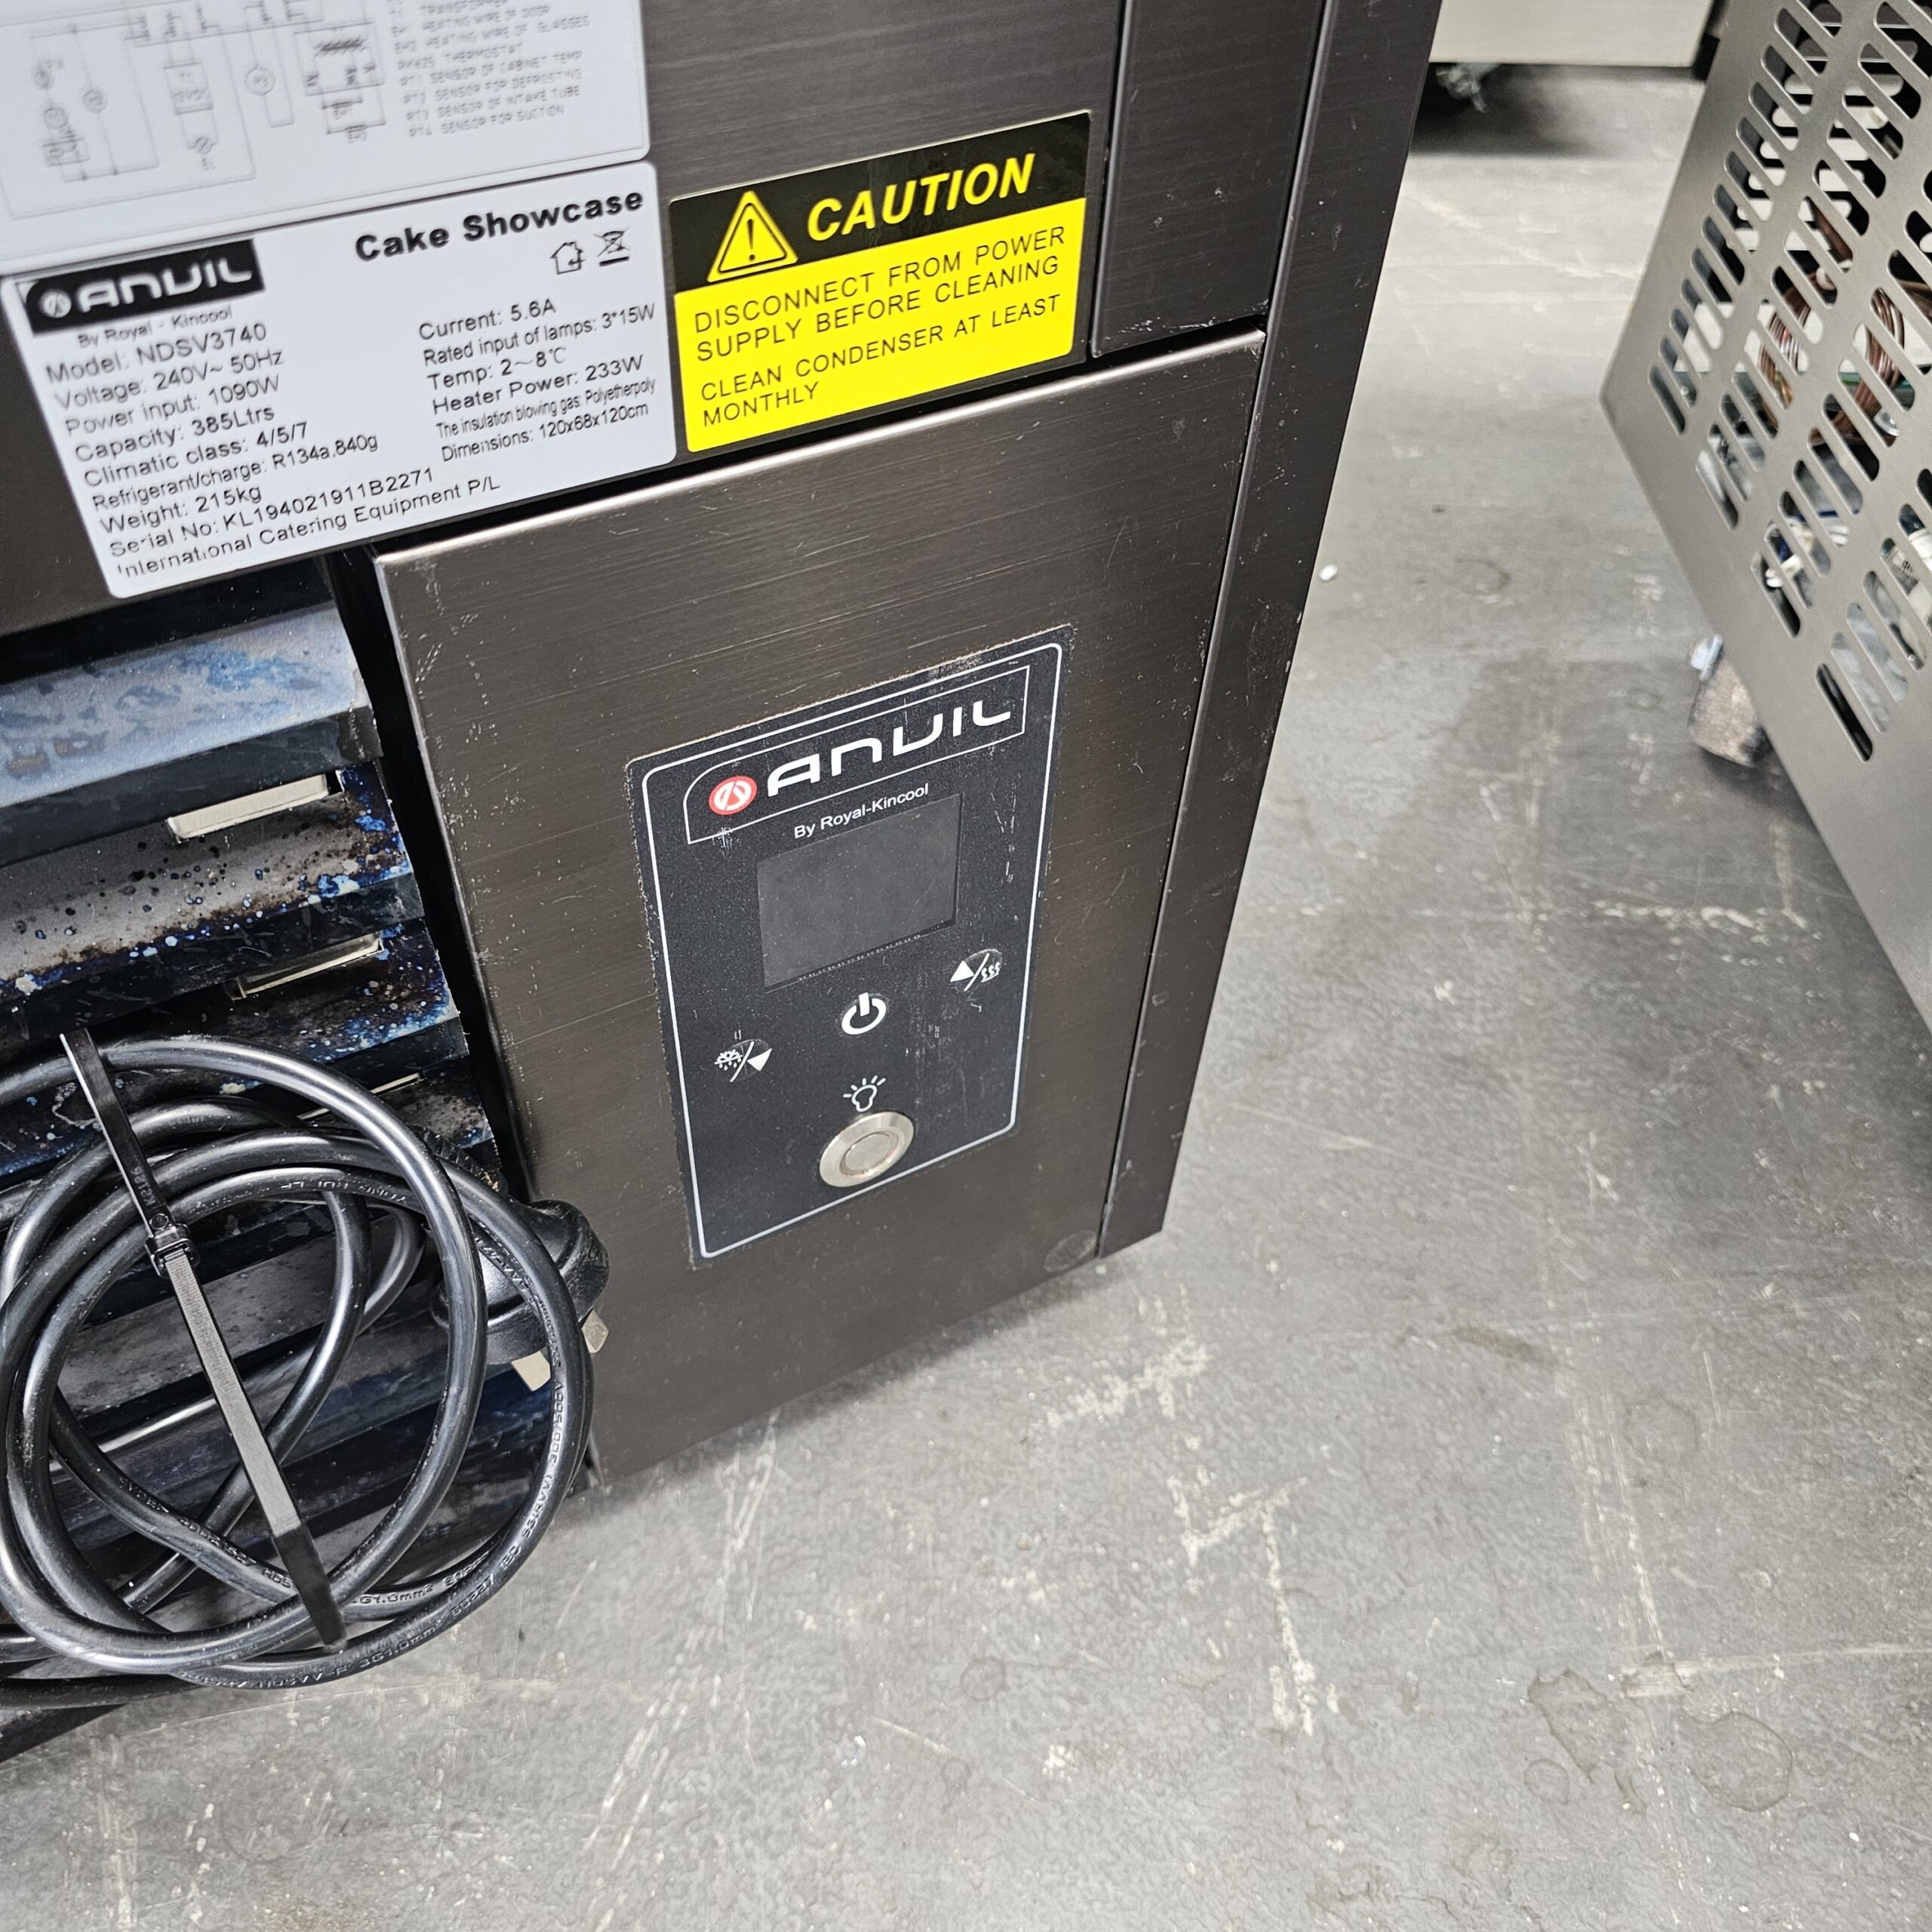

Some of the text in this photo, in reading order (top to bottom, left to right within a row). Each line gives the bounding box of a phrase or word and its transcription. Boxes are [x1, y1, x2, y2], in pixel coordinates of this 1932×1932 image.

[355, 192, 643, 261] Cake Showcase
[808, 154, 1035, 240] CAUTION
[78, 258, 253, 313] ANVIL
[695, 226, 1064, 333] DISCONNECT FROM POWER
[698, 256, 1057, 361] SUPPLY BEFORE CLEANING
[78, 334, 99, 349] By
[104, 321, 153, 341] Royal
[171, 306, 231, 327] Kincool
[419, 299, 555, 340] Current: 5.6A
[423, 341, 473, 365] Rated
[479, 332, 518, 355] input
[525, 327, 539, 345] of
[544, 318, 596, 340] lamps:
[702, 294, 1060, 400] CLEAN CONDENSER AT LEAST
[46, 323, 266, 382] Model: NDSV3740
[54, 382, 146, 409] Voltage:
[231, 350, 281, 374] 50Hz
[427, 367, 494, 391] Temp:
[64, 375, 278, 436] Power input: 1090W
[433, 355, 642, 414] Heater Power: 233W
[704, 382, 818, 426] MONTHLY
[75, 408, 274, 461] Capacity: 385Ltrs
[436, 423, 459, 436] The
[462, 411, 512, 432] insulation
[516, 401, 557, 420] blowing
[441, 404, 648, 462] Dimensions: 120x68x120cm
[85, 422, 306, 486] Climatic class: 4/5/7
[92, 460, 266, 508] Refrigerant/charge:
[100, 487, 261, 533] Weight: 215kg
[110, 468, 432, 556] Serial No: KL194021911B2271
[260, 515, 346, 544] Catering
[354, 485, 460, 522] Equipment
[468, 476, 500, 494] P/L
[767, 700, 1011, 797] ANVIL
[795, 783, 928, 838] By Royal-Kincool
